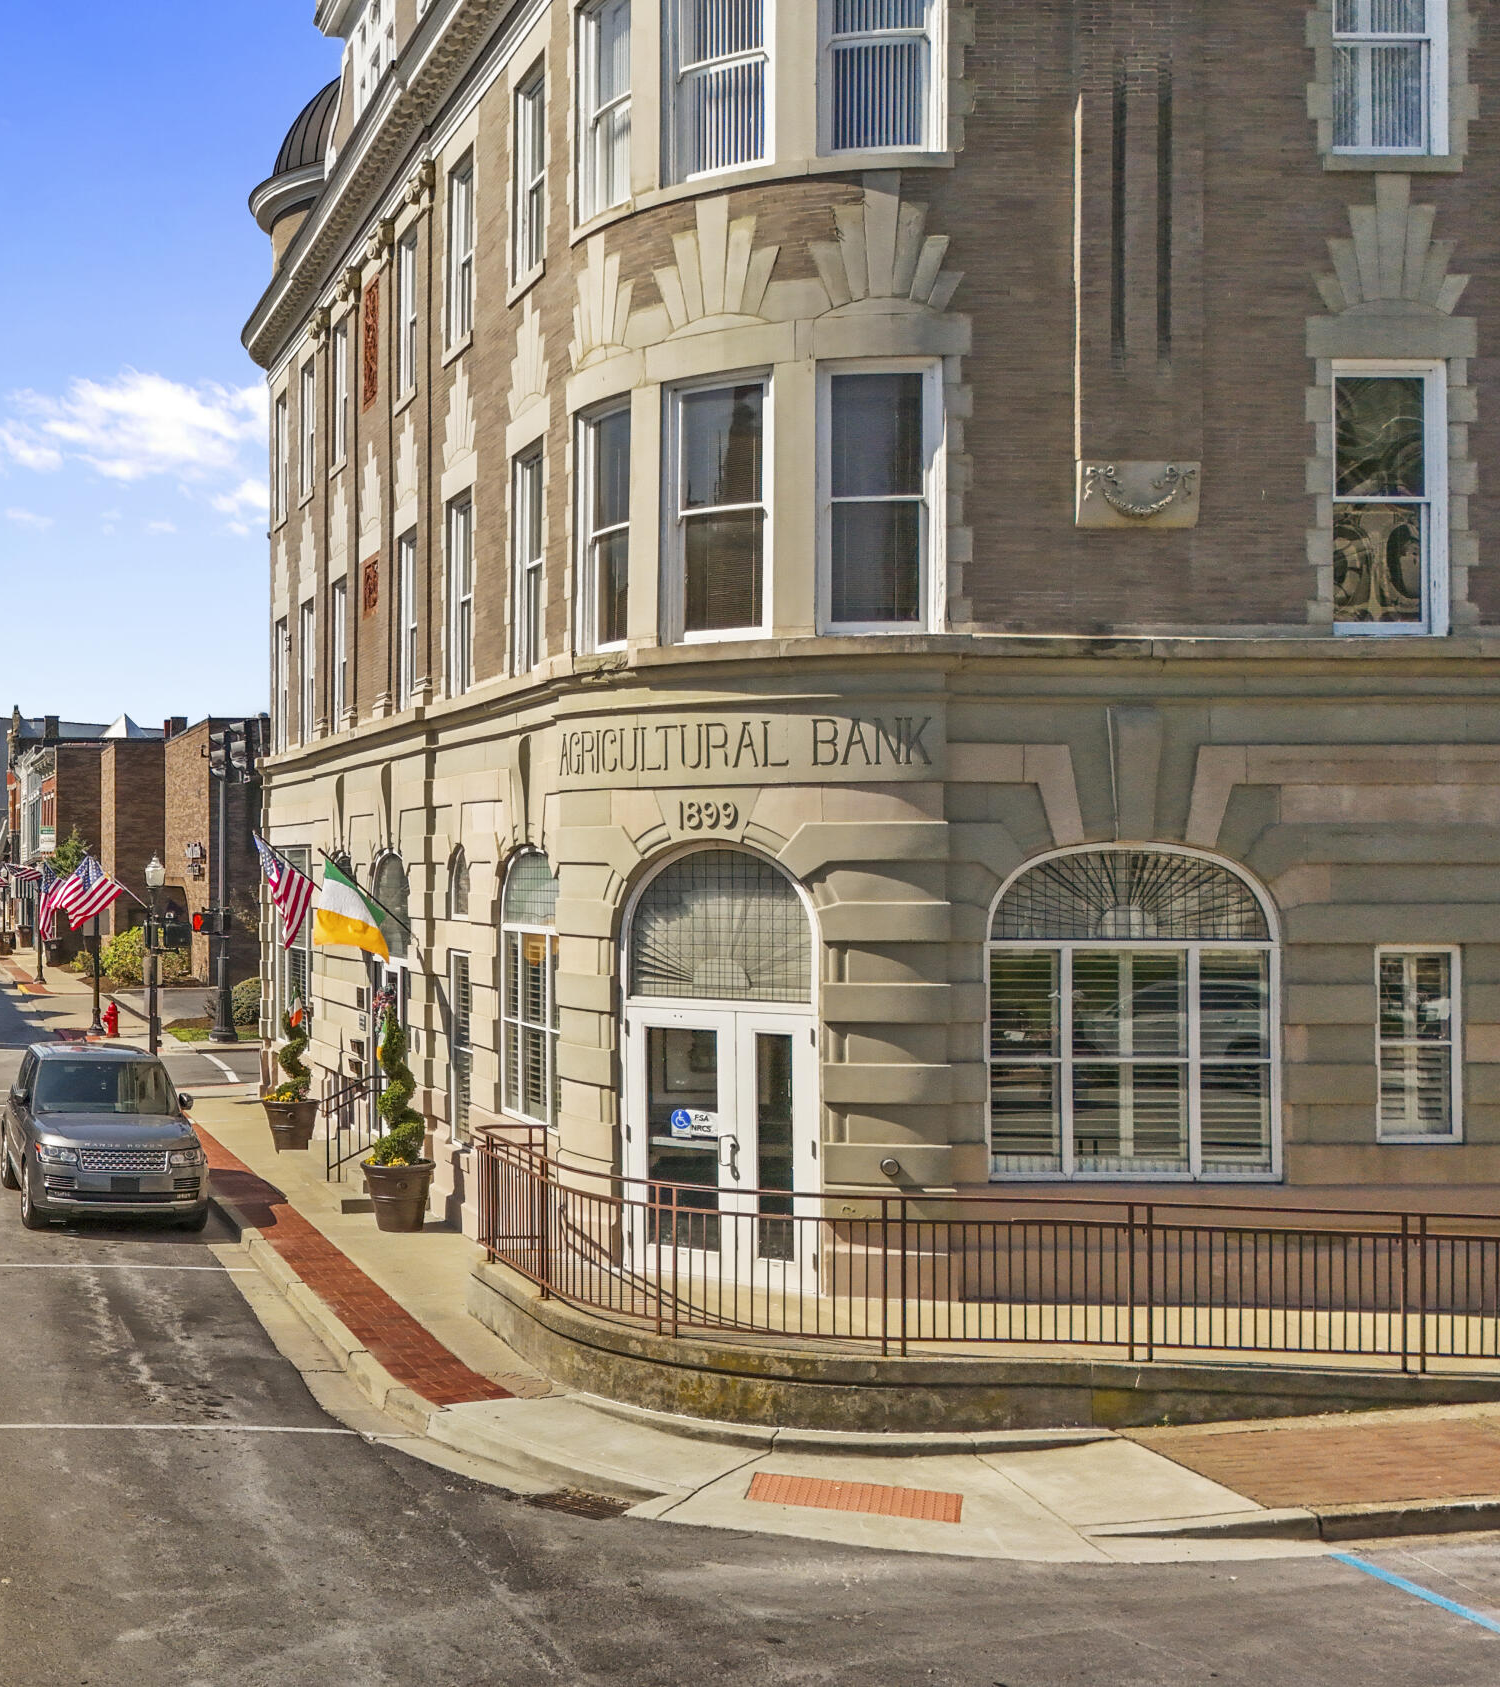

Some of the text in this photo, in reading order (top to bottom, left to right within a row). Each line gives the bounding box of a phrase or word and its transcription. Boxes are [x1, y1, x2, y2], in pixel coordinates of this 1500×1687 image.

[558, 716, 933, 776] AGRICULTURAL BANK
[679, 800, 739, 831] 1899
[694, 1114, 709, 1122] FSA
